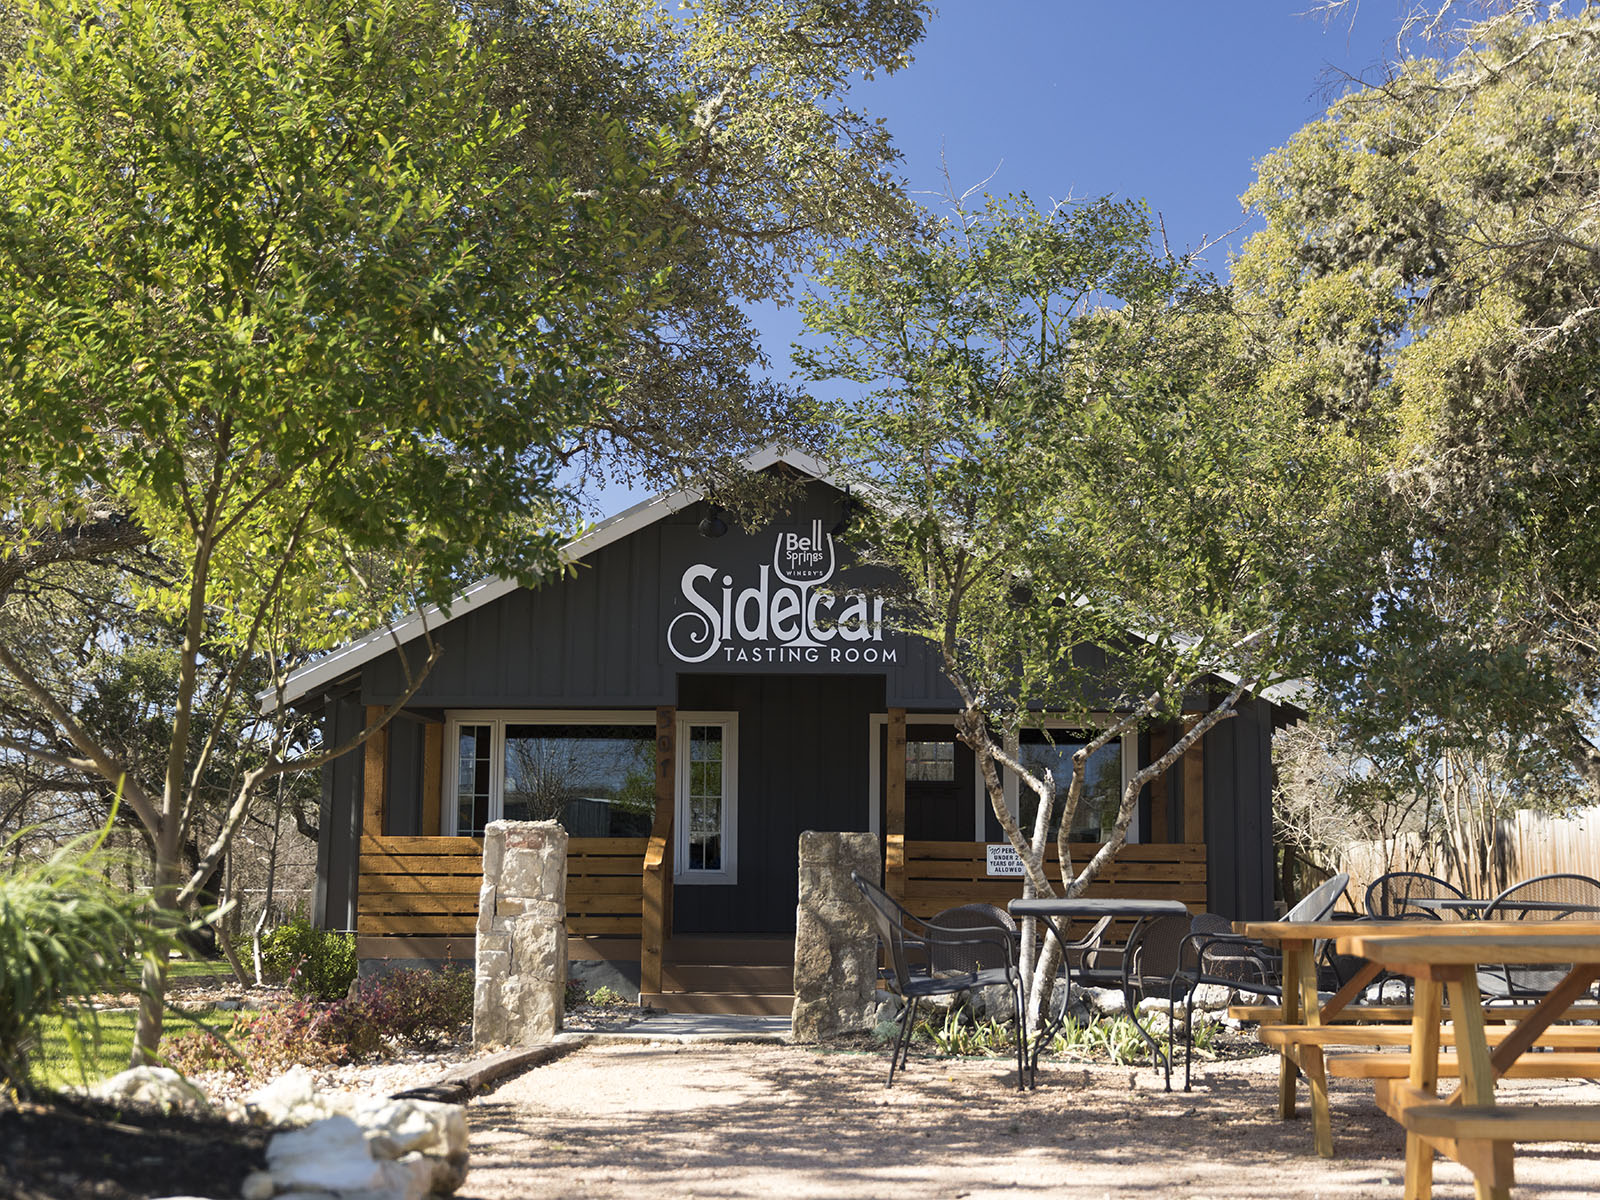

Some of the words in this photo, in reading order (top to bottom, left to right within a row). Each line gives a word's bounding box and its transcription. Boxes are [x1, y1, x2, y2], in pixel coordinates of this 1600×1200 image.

[786, 519, 822, 551] Bell
[786, 551, 823, 570] Springs
[667, 564, 885, 663] Sidecar
[724, 647, 819, 663] TASTING
[831, 647, 897, 663] ROOM
